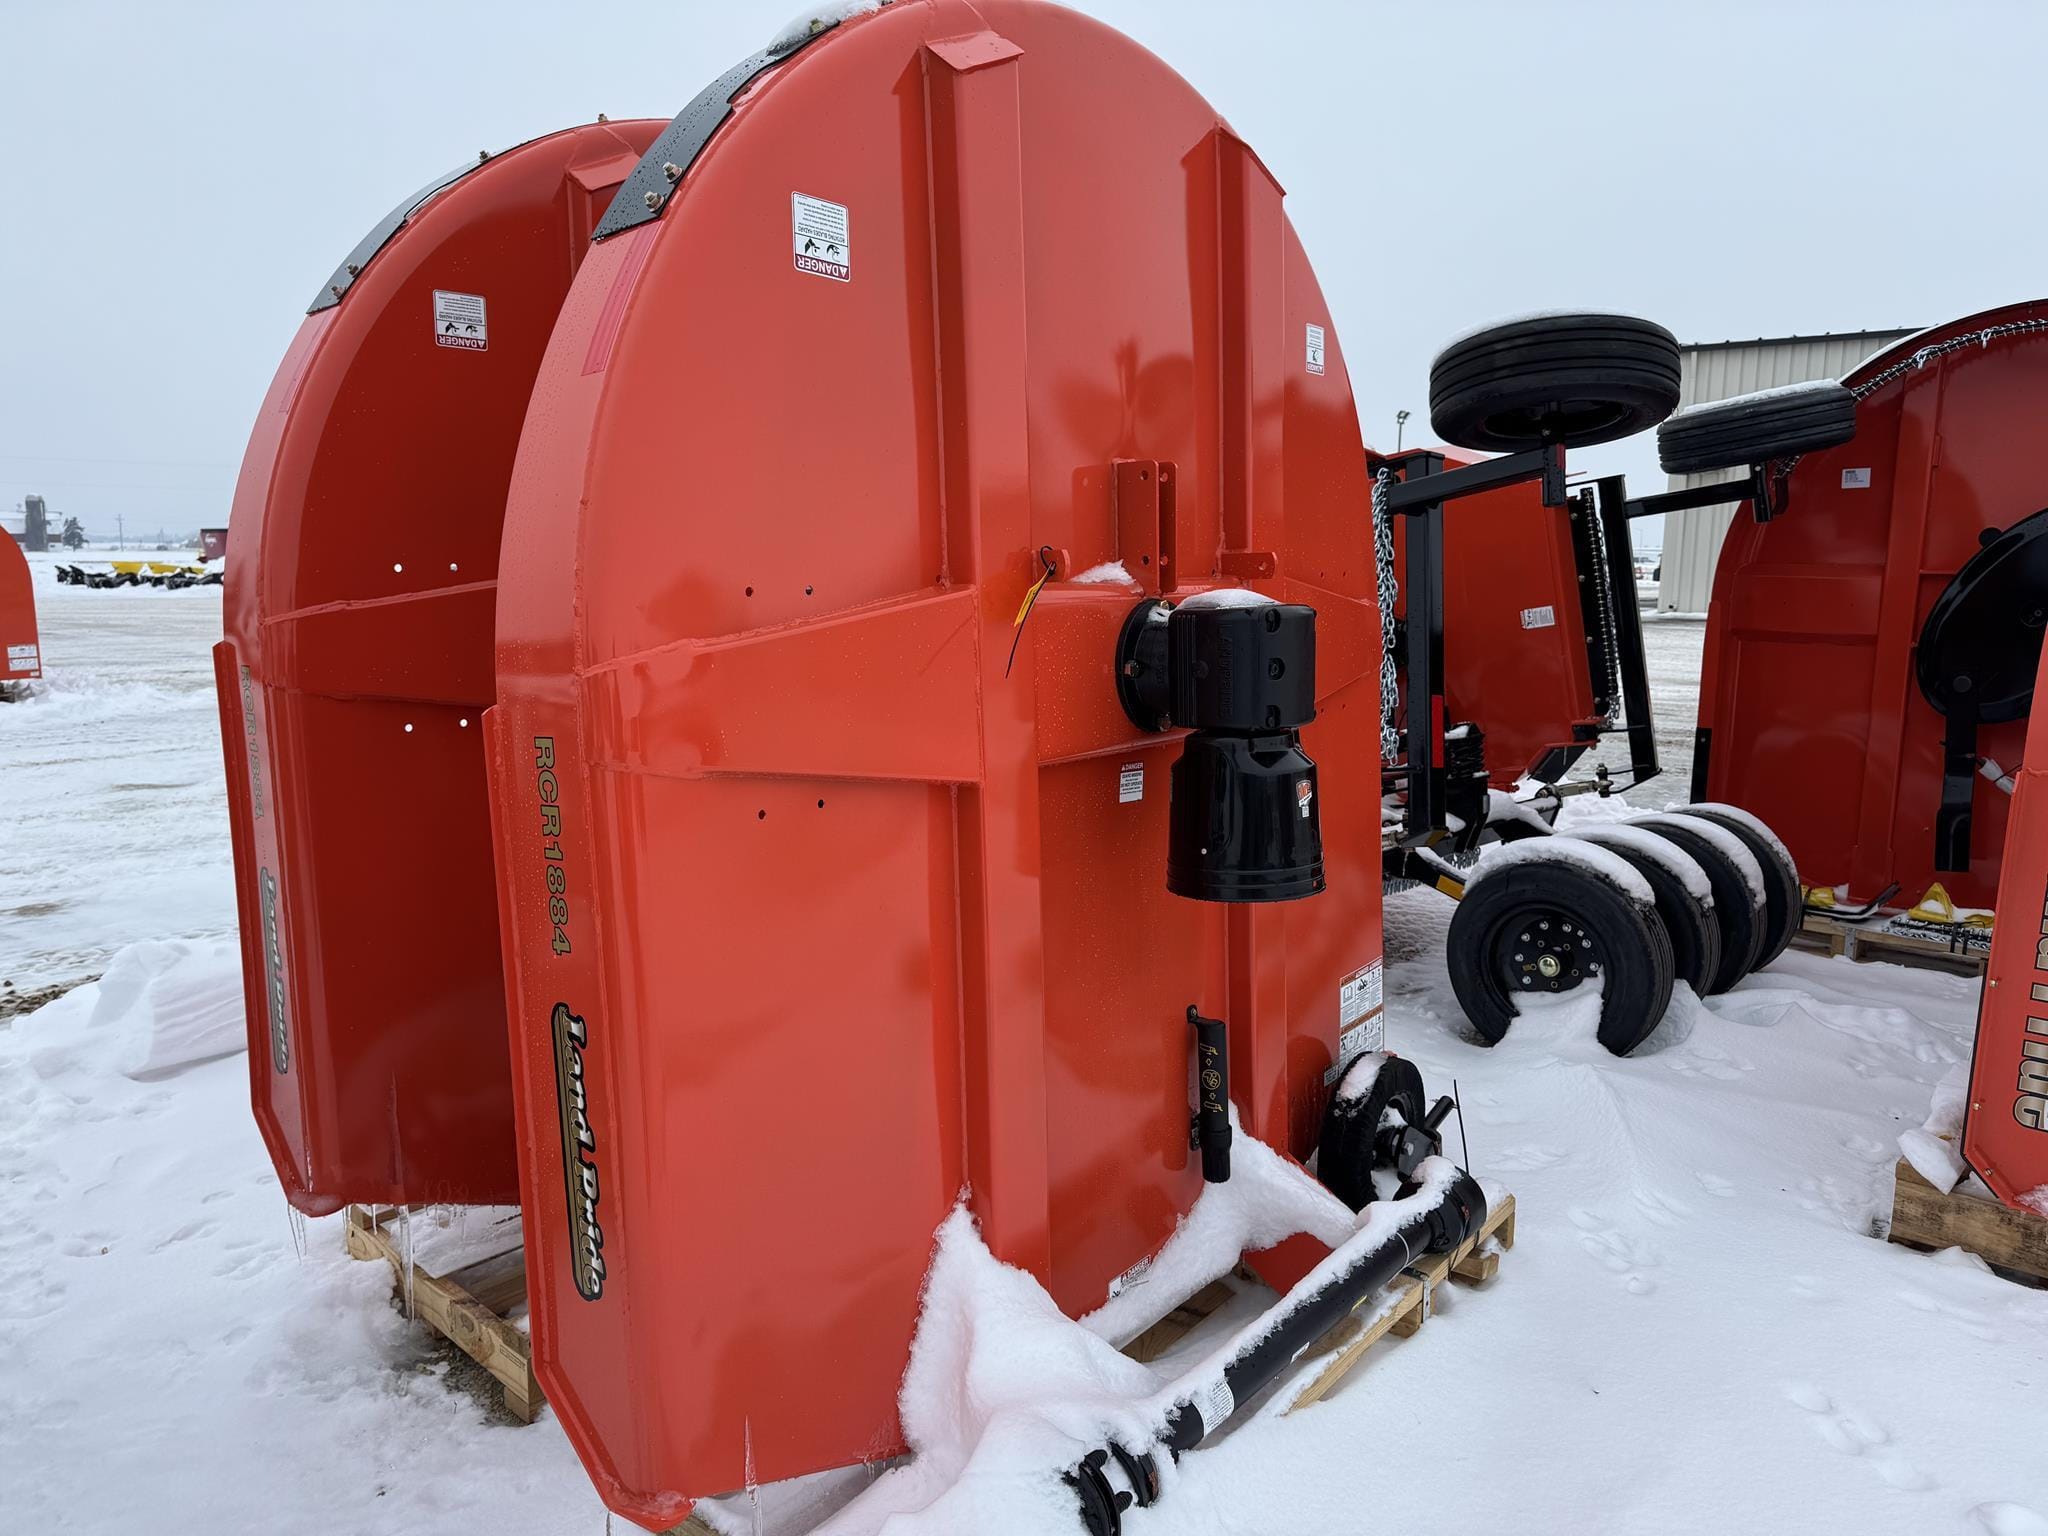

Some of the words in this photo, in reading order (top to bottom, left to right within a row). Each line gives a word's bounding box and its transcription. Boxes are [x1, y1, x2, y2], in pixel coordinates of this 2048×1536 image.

[797, 256, 839, 275] DANGER
[439, 335, 477, 347] DANGER
[534, 736, 572, 956] RCR1884
[562, 1012, 594, 1148] Land
[574, 1154, 607, 1296] Pride
